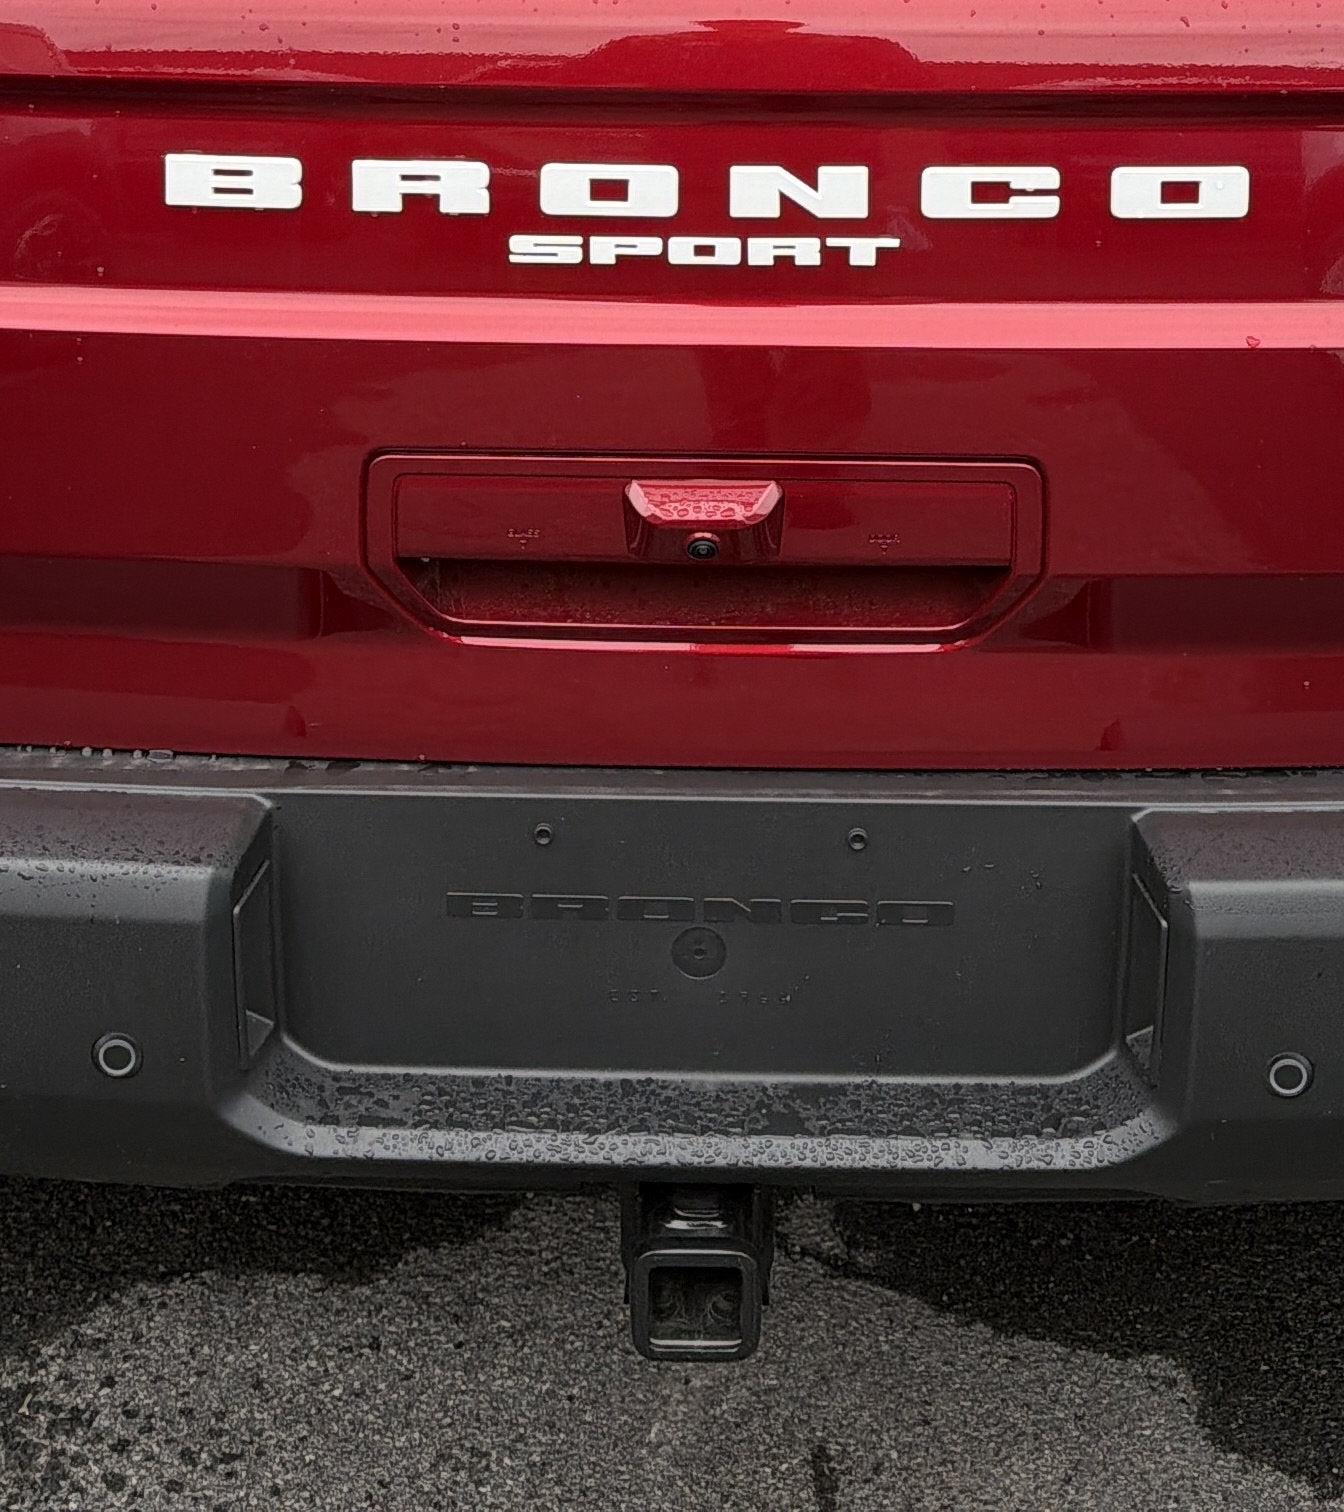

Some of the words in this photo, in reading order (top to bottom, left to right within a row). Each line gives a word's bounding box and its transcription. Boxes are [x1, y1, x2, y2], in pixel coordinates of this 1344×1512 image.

[162, 152, 1251, 220] BRONCO
[508, 234, 901, 267] SPORT
[445, 892, 954, 926] BRONCO
